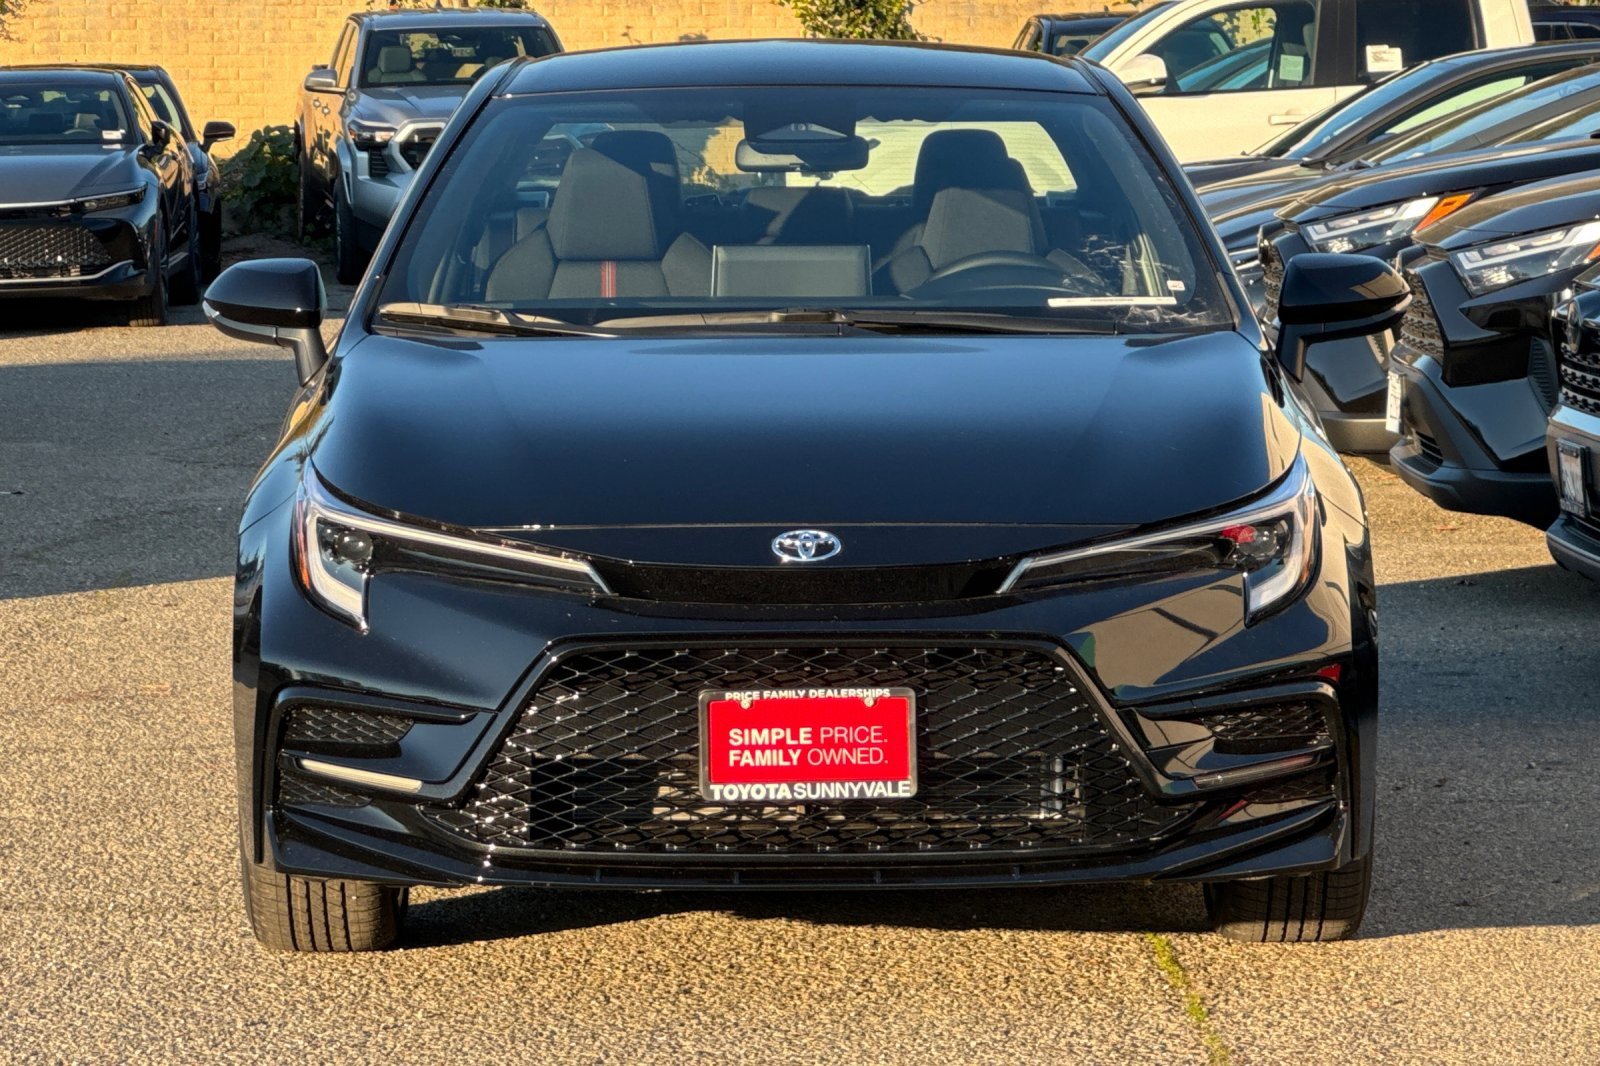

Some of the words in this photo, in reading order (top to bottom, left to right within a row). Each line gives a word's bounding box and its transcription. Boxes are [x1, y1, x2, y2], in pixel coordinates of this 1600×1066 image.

[724, 691, 760, 701] PRICE
[764, 689, 805, 699] FAMILY
[809, 688, 890, 698] DEALERSHIPS
[729, 728, 813, 746] SIMPLE
[820, 726, 888, 744] PRICE.
[729, 750, 801, 767] FAMILY
[807, 748, 888, 766] OWNED.
[710, 784, 793, 800] TOYOTA
[793, 781, 910, 798] SUNNYVALE
